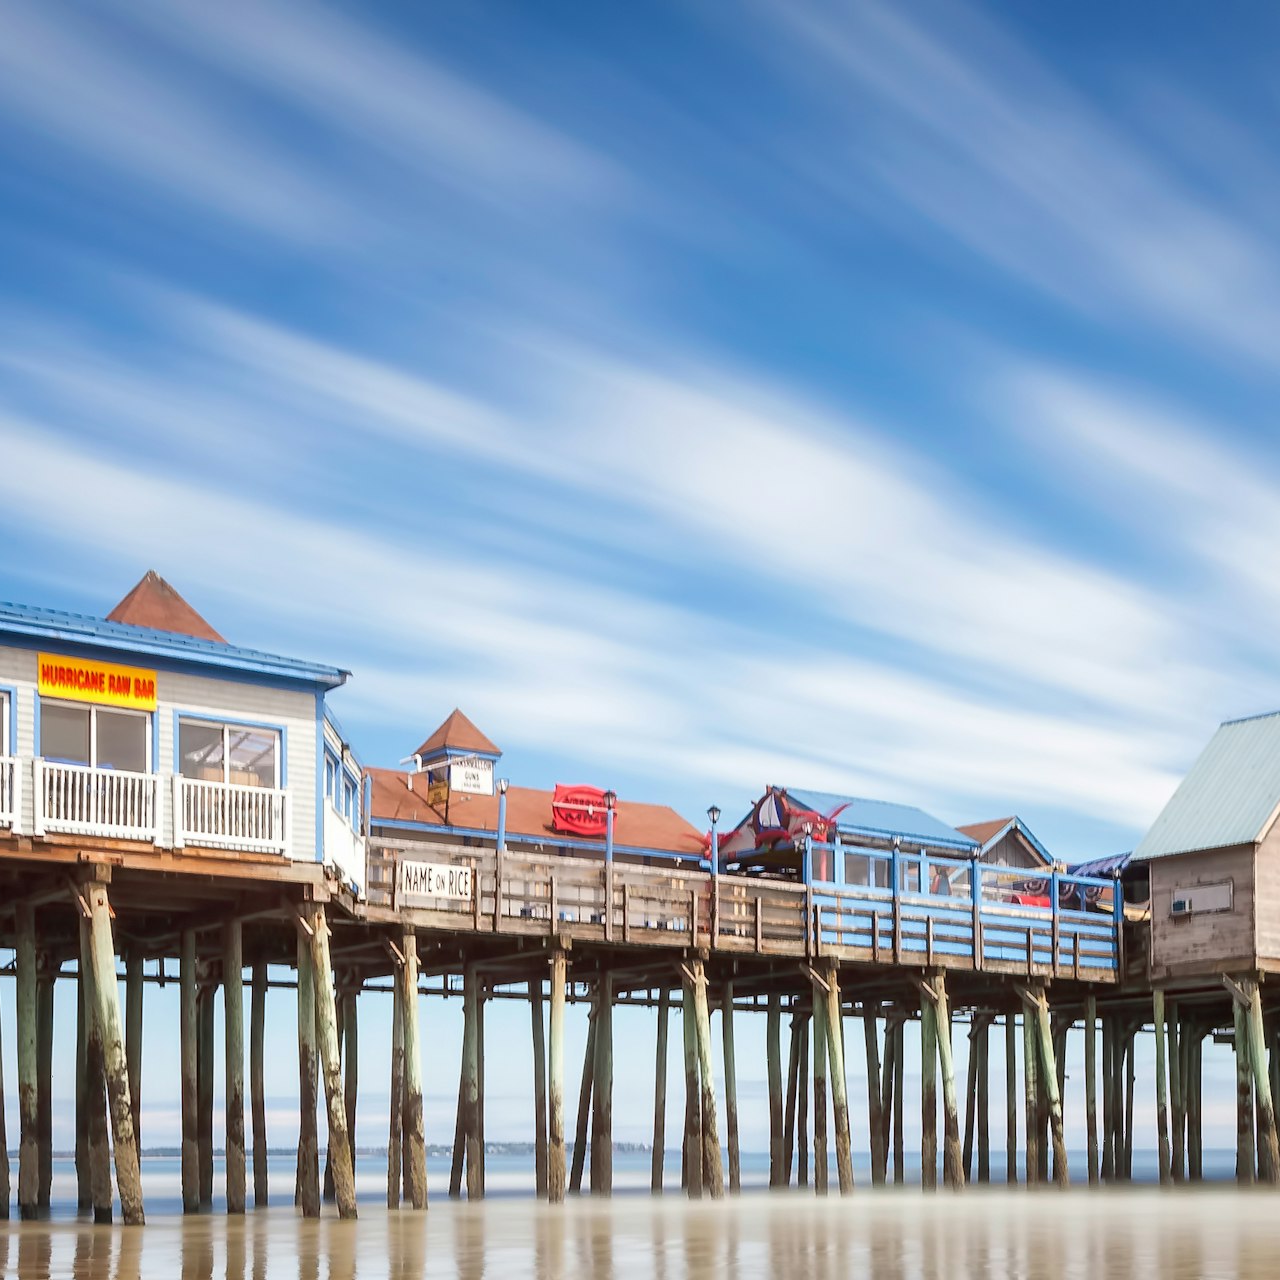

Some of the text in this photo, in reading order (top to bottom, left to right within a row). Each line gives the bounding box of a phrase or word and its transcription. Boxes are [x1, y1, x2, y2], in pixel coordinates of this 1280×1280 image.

[41, 664, 155, 700] HURRICANE RAW BAR
[405, 864, 433, 893] NAME
[448, 870, 469, 896] RICE
